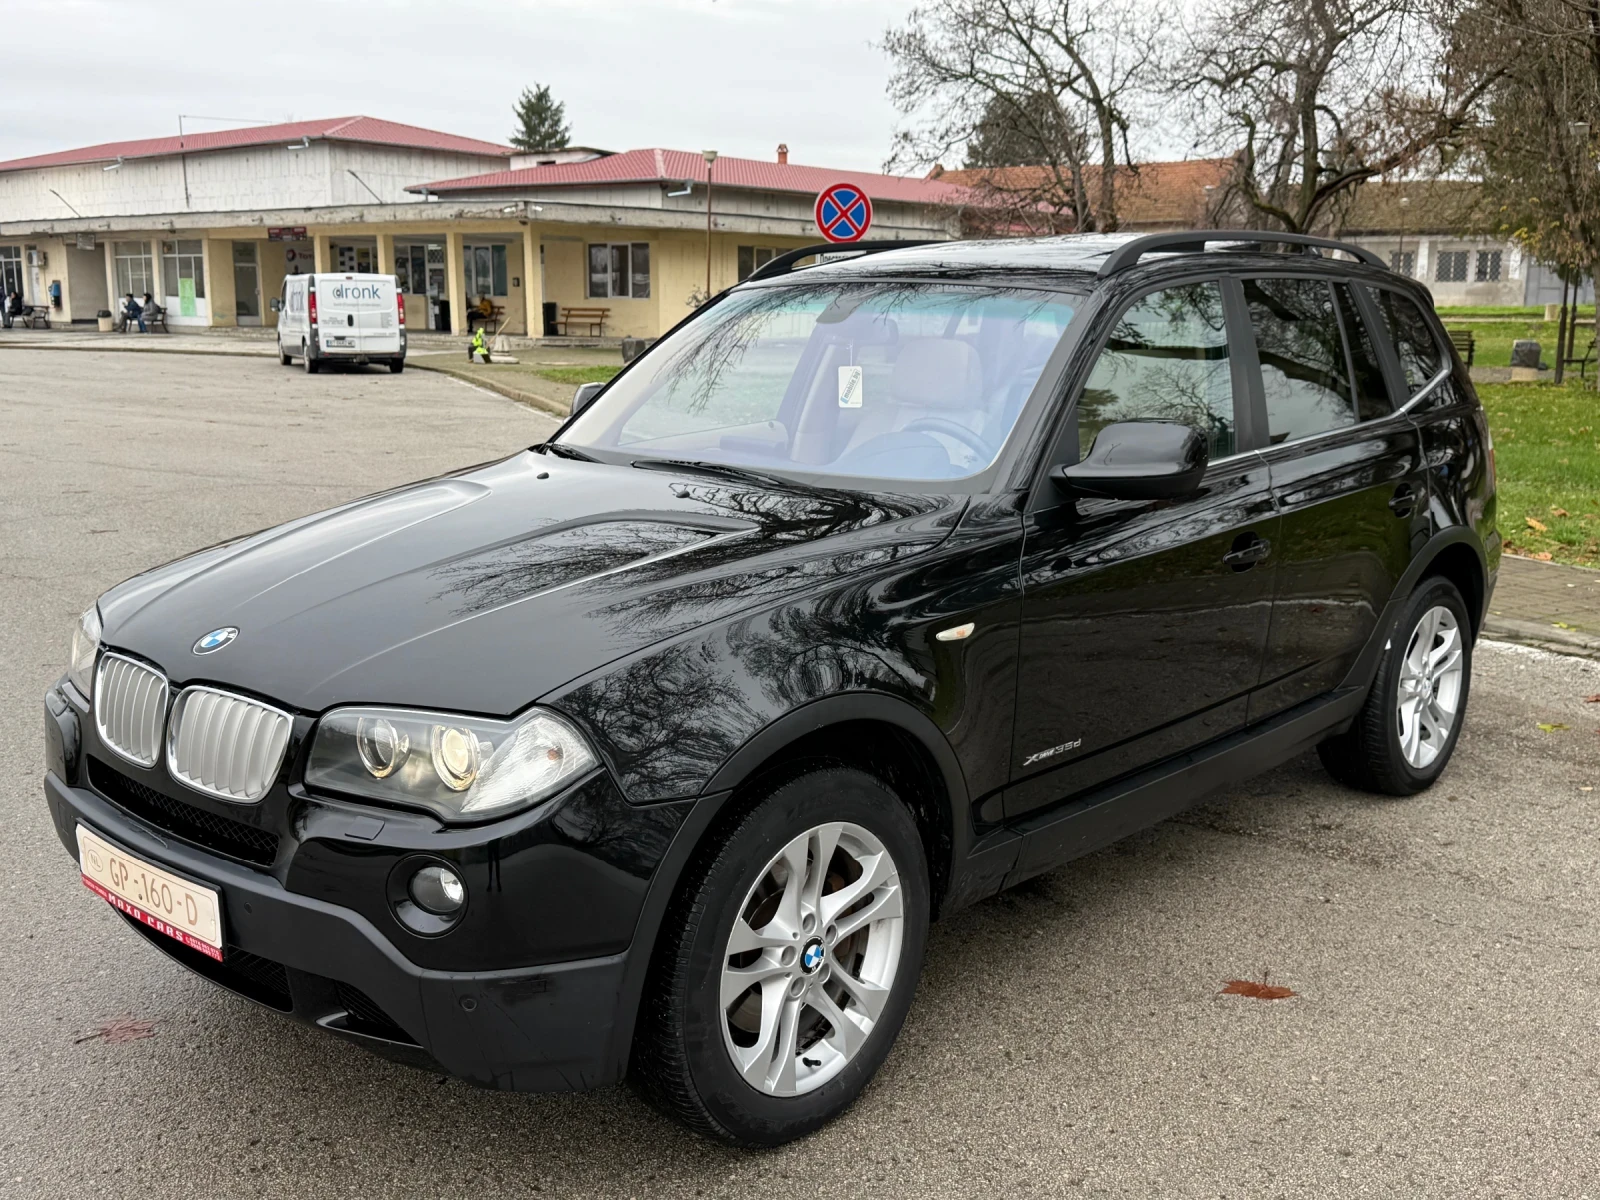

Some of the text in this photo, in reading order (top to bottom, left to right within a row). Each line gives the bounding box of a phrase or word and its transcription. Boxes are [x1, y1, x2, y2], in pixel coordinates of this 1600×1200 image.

[844, 371, 861, 399] mobile.bg
[108, 893, 183, 942] MAXO CARS
